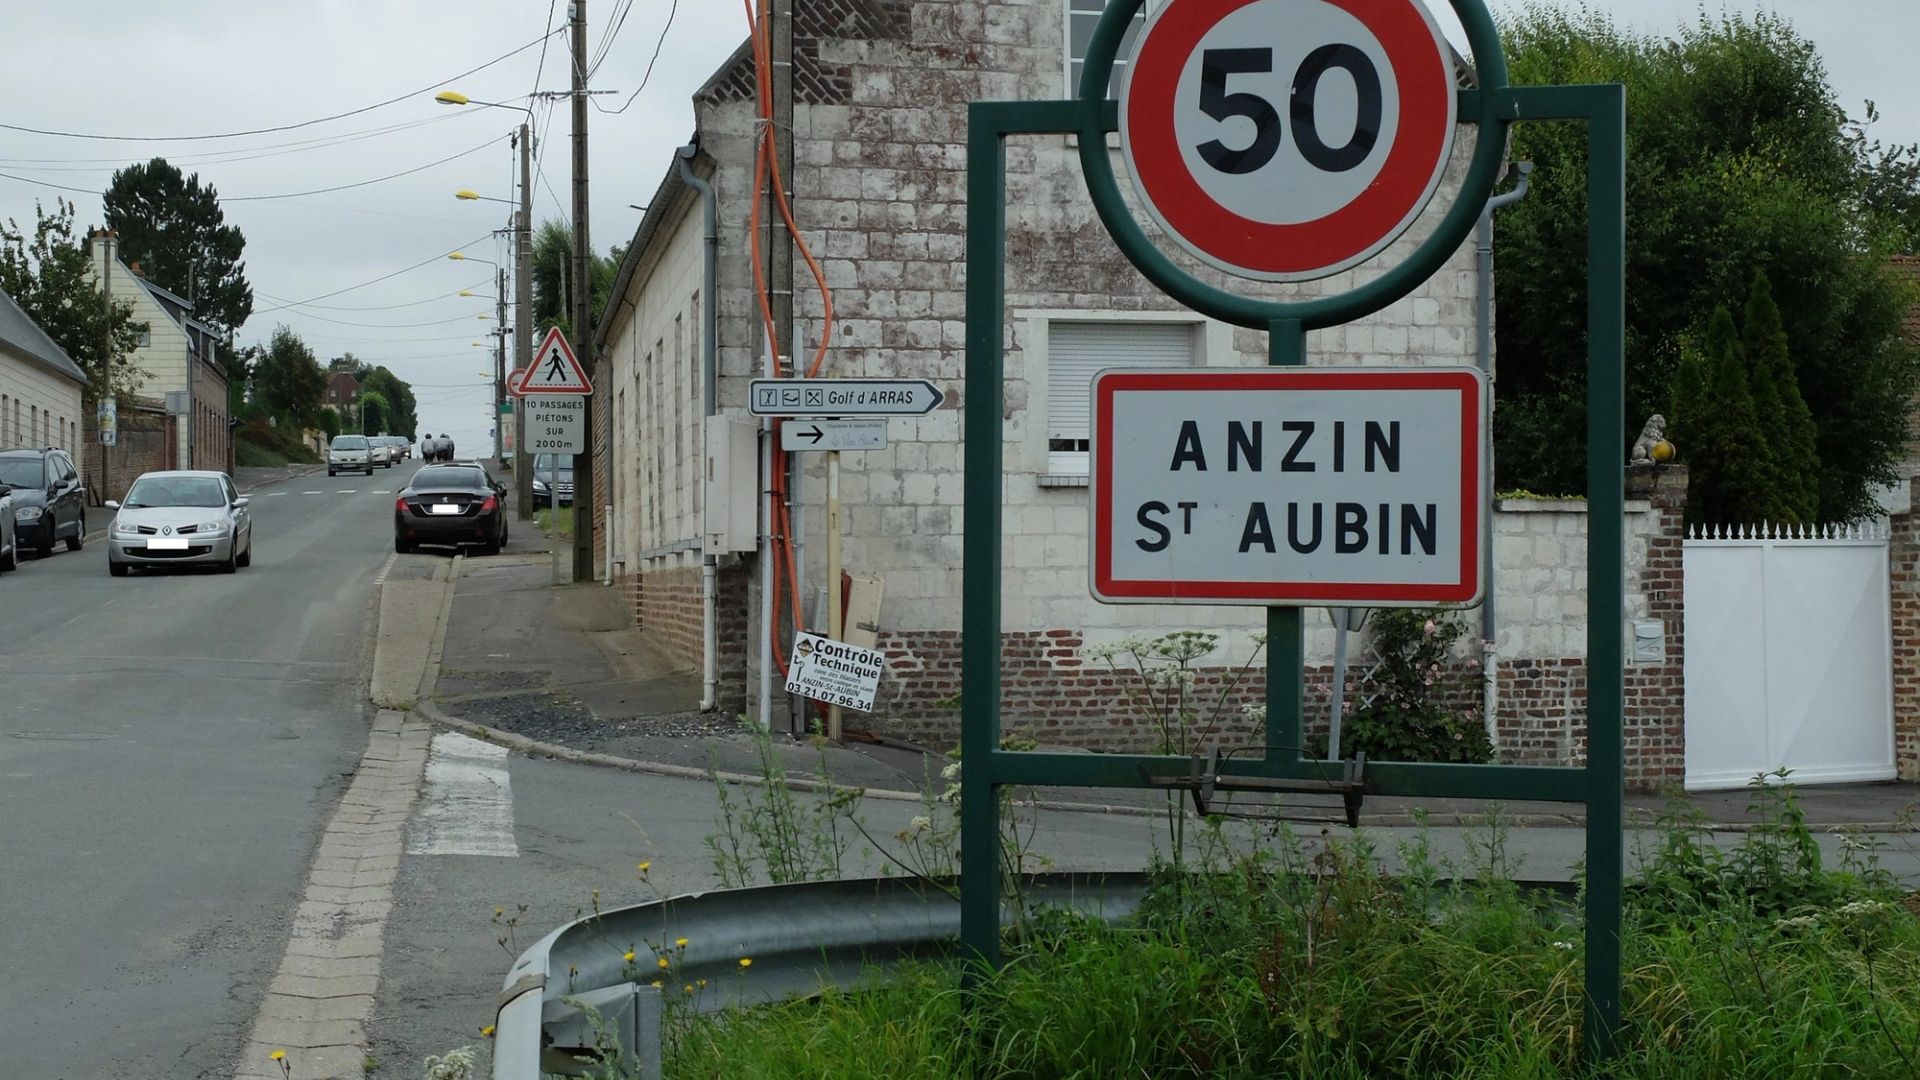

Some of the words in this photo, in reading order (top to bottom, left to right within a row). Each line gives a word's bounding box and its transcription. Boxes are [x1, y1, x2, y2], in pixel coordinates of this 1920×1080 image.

[1196, 43, 1382, 174] 50
[526, 401, 537, 409] 10
[540, 401, 584, 410] PASSAGES
[828, 391, 854, 405] Golf
[857, 391, 913, 405] d'ARRAS
[535, 440, 573, 448] 2000m
[545, 427, 564, 436] SUR
[1169, 420, 1400, 473] ANZIN
[1238, 501, 1437, 555] AUBIN
[812, 653, 878, 679] Technique
[814, 639, 883, 668] Contrôle
[787, 681, 872, 712] 03.21.07.96.34
